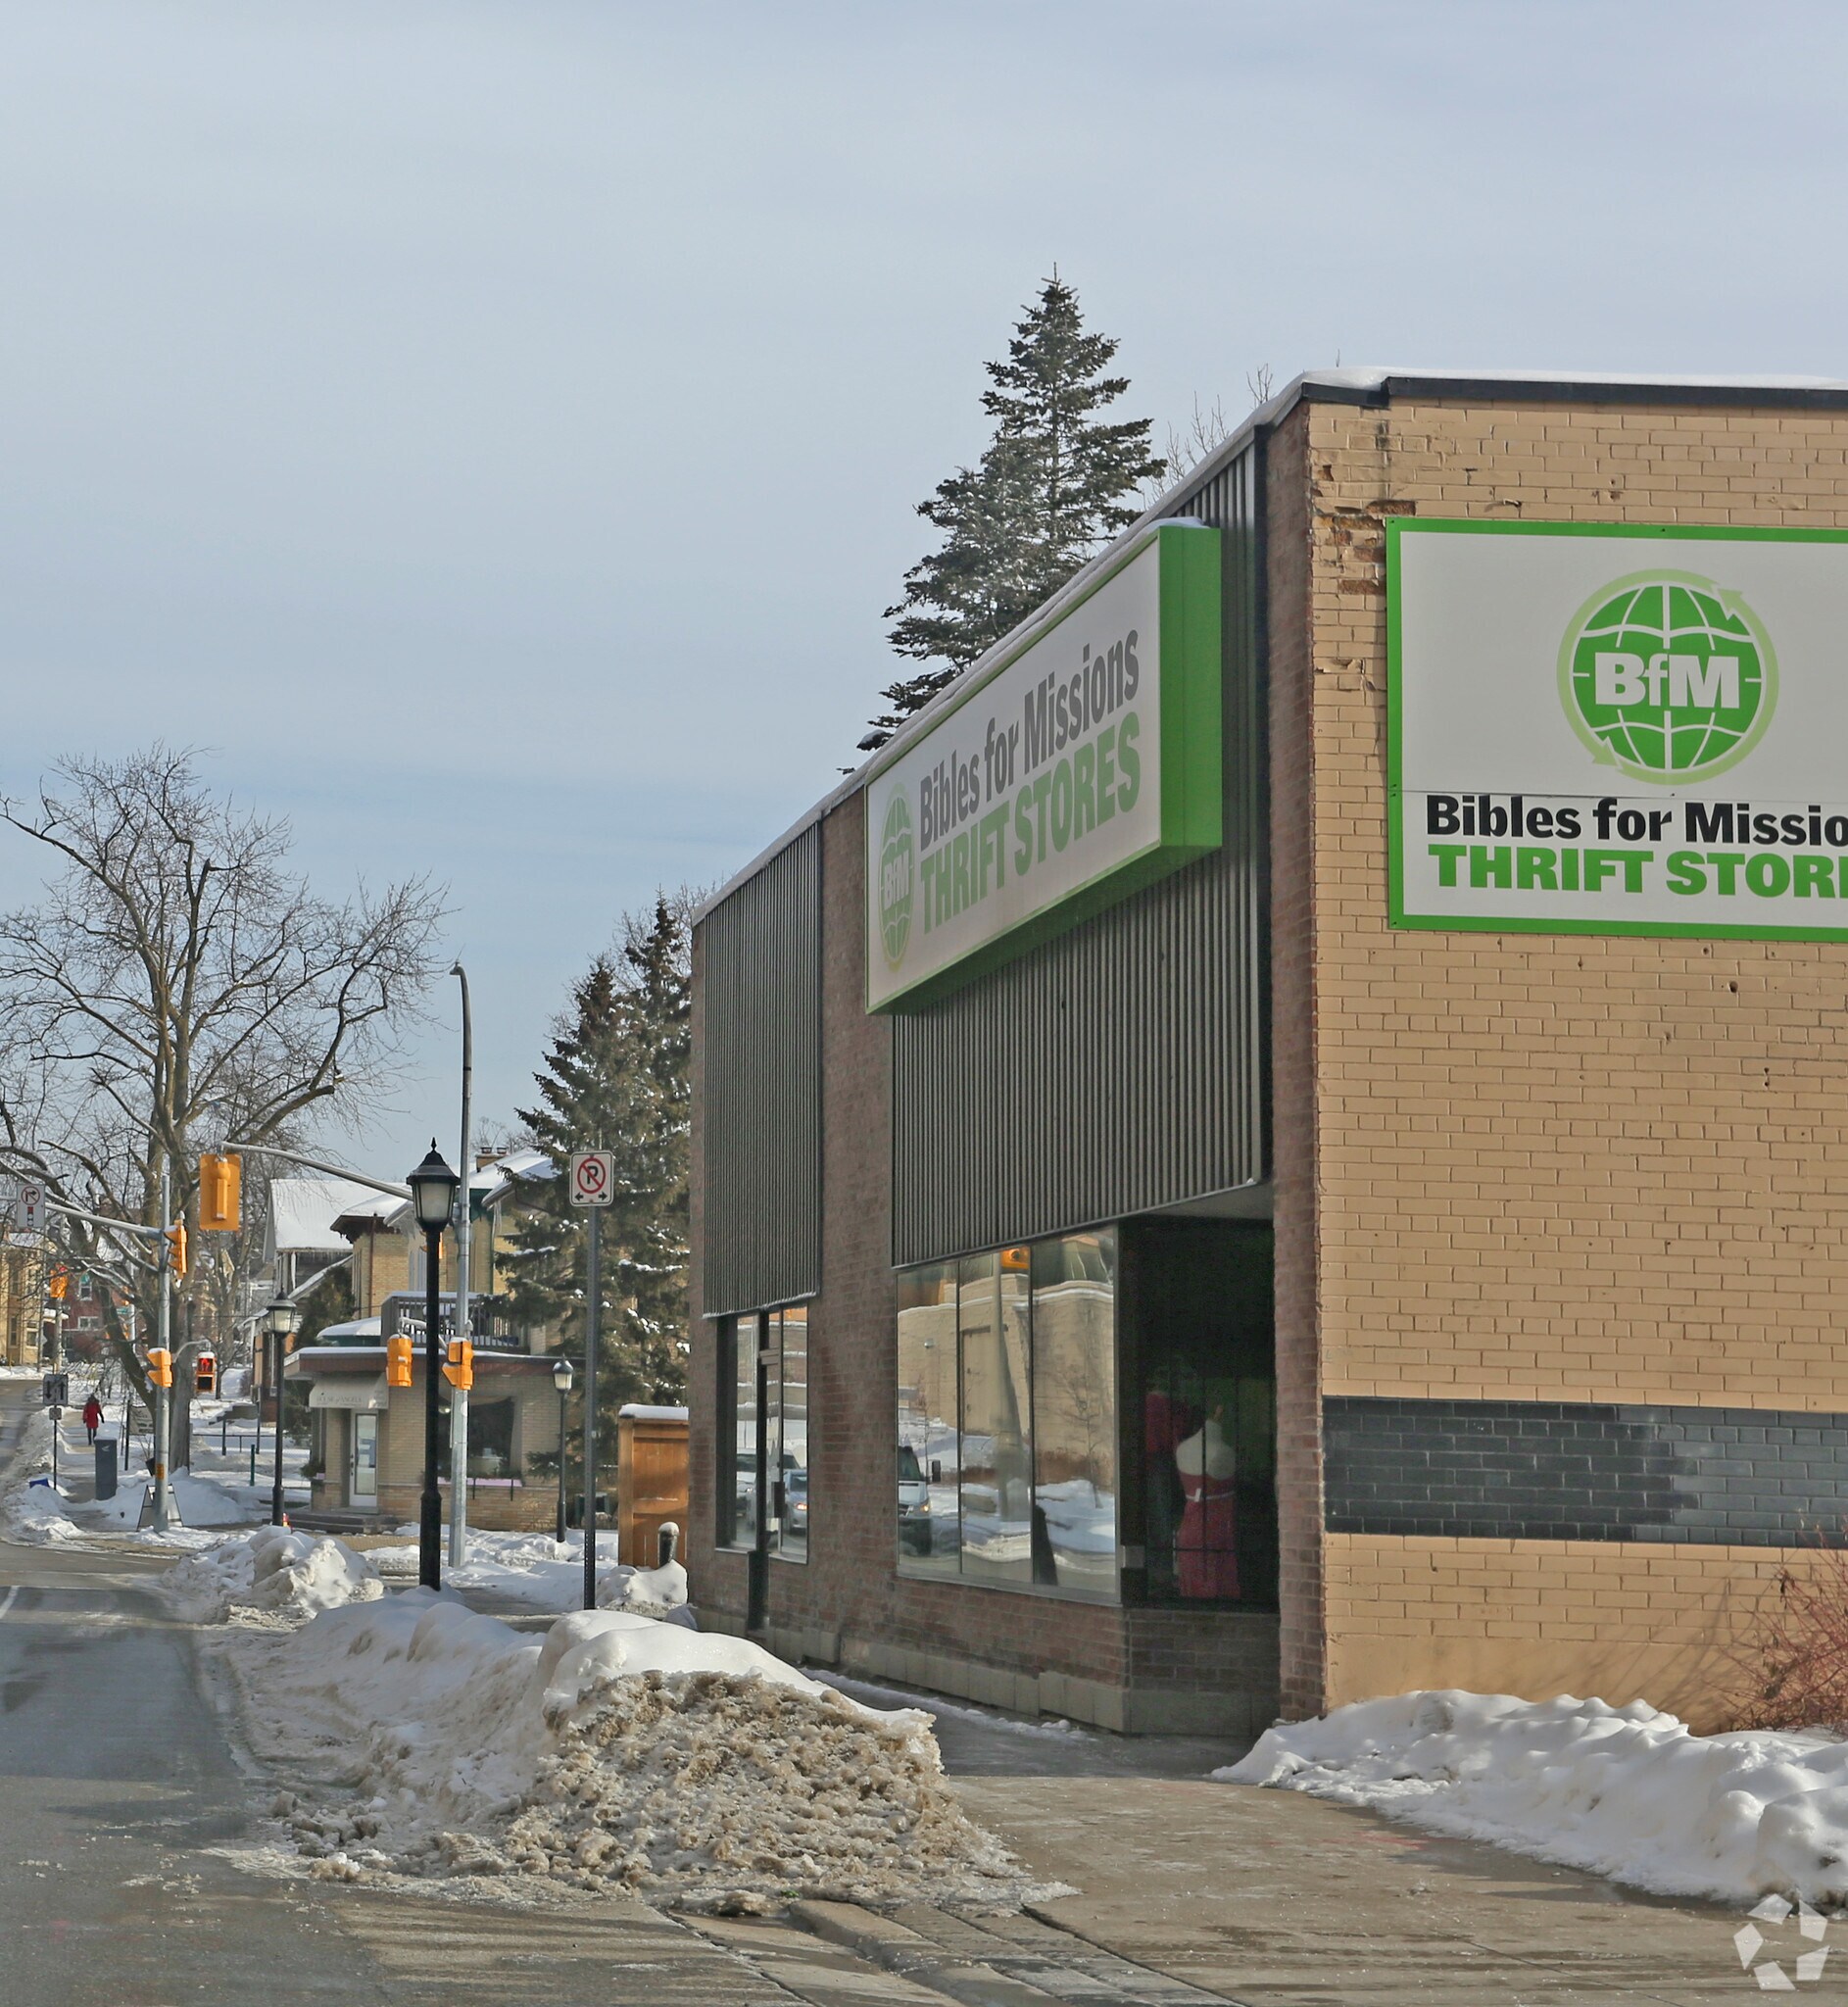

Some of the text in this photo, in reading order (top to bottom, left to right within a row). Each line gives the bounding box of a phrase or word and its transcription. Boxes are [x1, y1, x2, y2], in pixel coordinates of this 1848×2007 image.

[1594, 652, 1739, 709] BfM
[920, 629, 1140, 852] Bibles for Missions
[920, 711, 1141, 935] THRIFT STORES
[1427, 794, 1848, 848] Bibles for Missio
[884, 849, 909, 911] BfM
[1428, 844, 1654, 893] THRIFT
[587, 1165, 599, 1185] P
